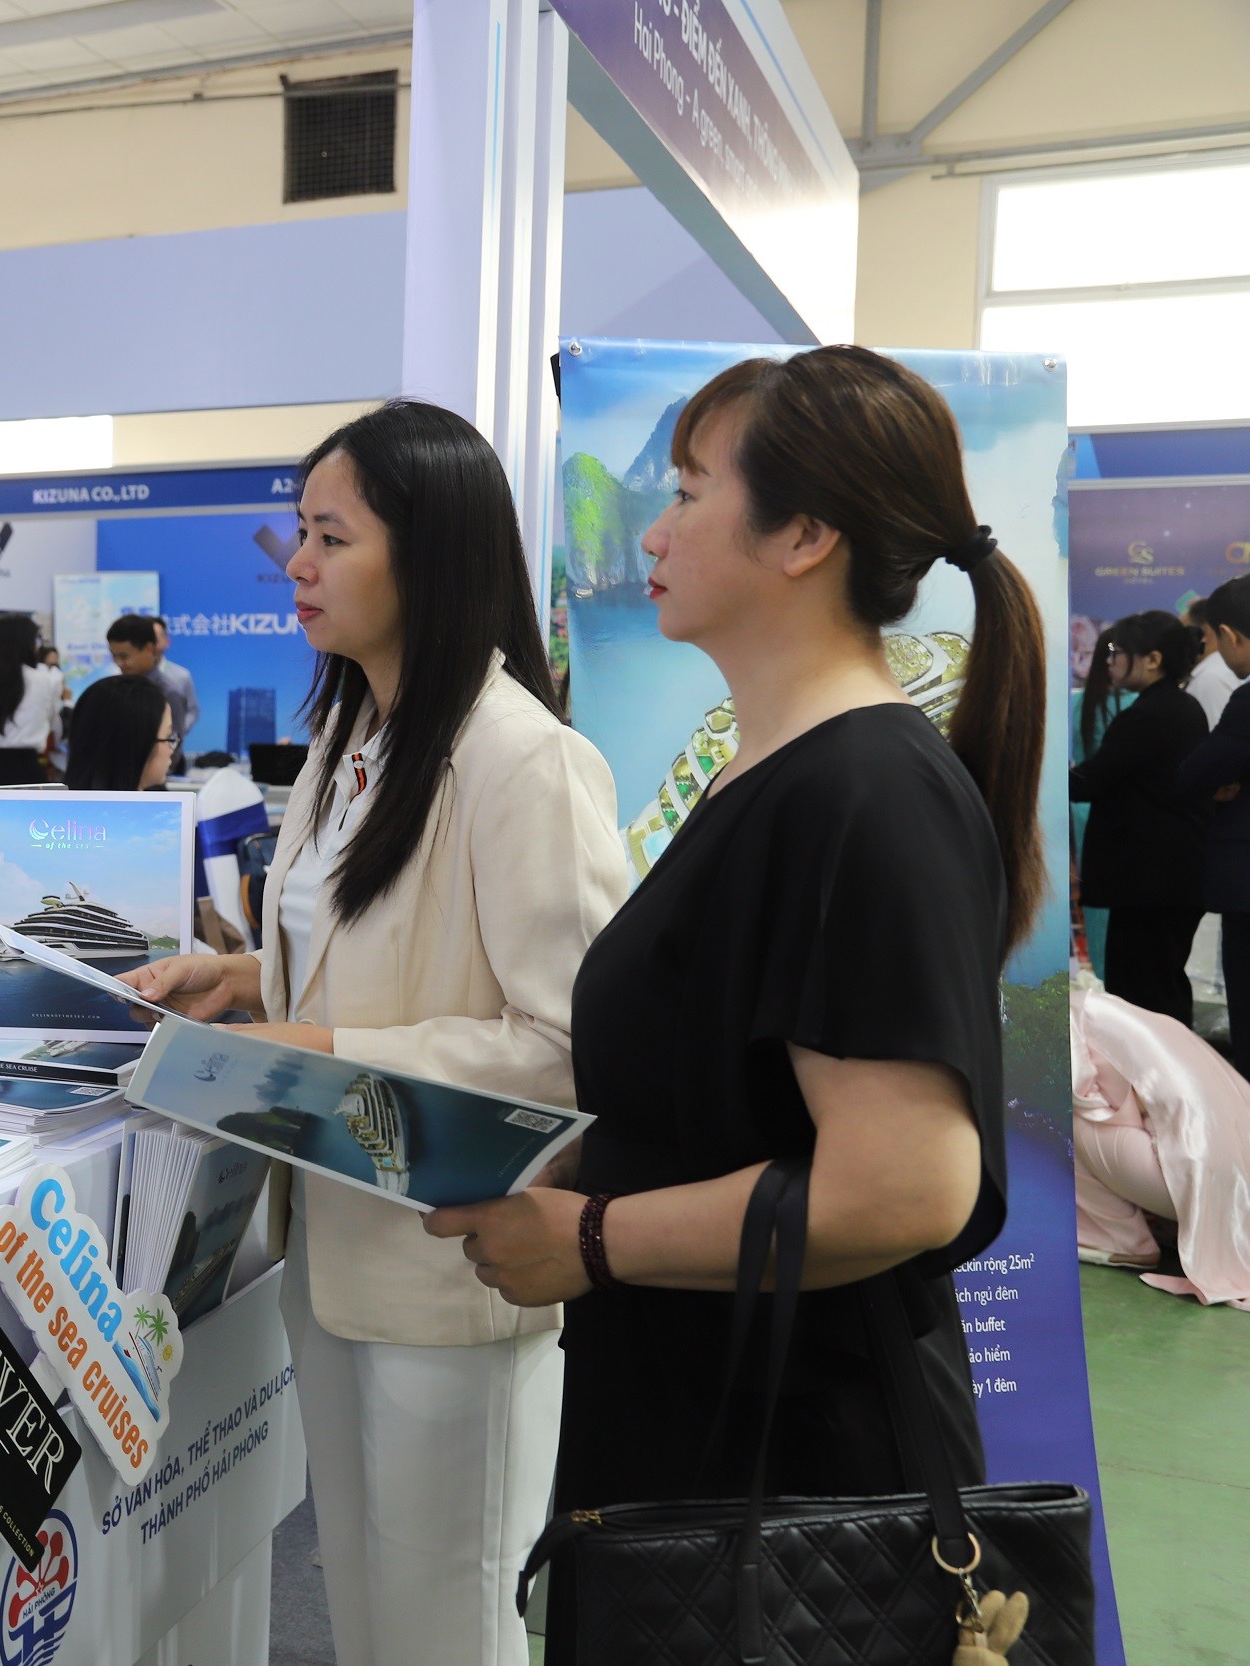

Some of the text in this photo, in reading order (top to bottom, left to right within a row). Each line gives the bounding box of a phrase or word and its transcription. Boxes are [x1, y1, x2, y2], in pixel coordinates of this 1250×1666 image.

[634, 1, 652, 64] Hai
[653, 31, 684, 116] Phong
[692, 88, 699, 129] A
[708, 38, 727, 104] ĐẾN
[33, 486, 90, 504] KIZUNA
[29, 819, 106, 840] Celina
[45, 841, 55, 850] of
[18, 1064, 38, 1073] CRUISE
[30, 1178, 122, 1343] Celina
[953, 1259, 982, 1272] eckin
[984, 1257, 1008, 1275] rộng
[974, 1286, 993, 1306] ngủ
[995, 1286, 1019, 1301] đêm
[975, 1316, 1006, 1333] buffet
[16, 1249, 54, 1314] the
[48, 1306, 88, 1370] sea
[82, 1360, 148, 1468] cruises
[984, 1344, 1011, 1363] hiểm
[986, 1378, 992, 1393] 1
[994, 1377, 1017, 1393] đêm
[102, 1495, 123, 1535] SỞ
[154, 1455, 185, 1494] HÓA,
[187, 1420, 212, 1466] THỂ
[212, 1406, 243, 1446] THAO
[244, 1388, 259, 1420] VÀ
[259, 1381, 274, 1408] DU
[140, 1420, 269, 1544] THÀNH PHỐ HẢI PHÒNG
[2, 1512, 35, 1557] COLLECTION
[22, 1587, 56, 1619] HẢI PHÒNG
